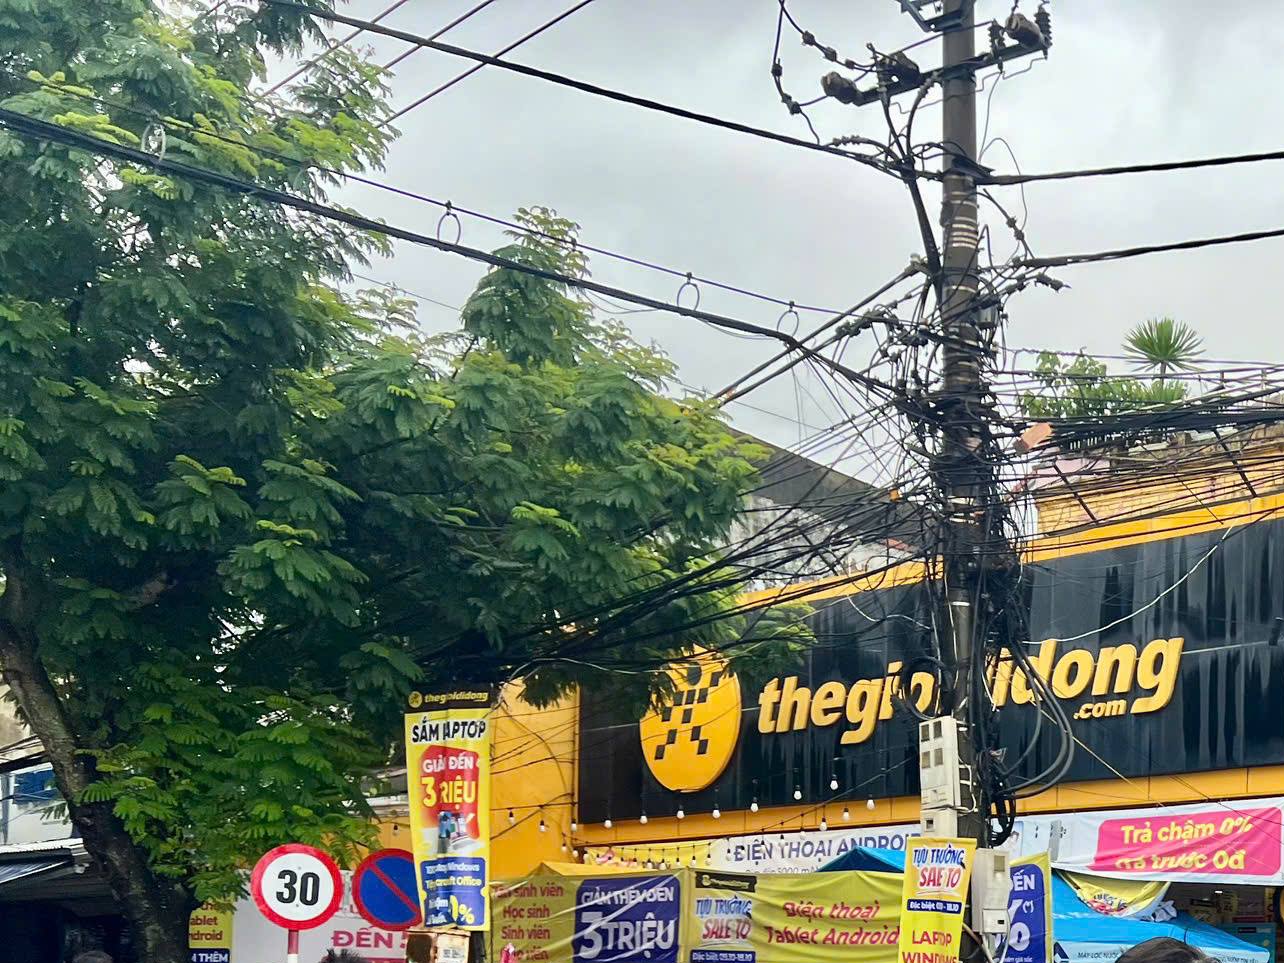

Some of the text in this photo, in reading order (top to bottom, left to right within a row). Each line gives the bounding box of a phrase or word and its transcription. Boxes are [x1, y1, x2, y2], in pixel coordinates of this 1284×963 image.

[1073, 699, 1127, 719] .com
[448, 752, 474, 770] ĐẾN
[421, 775, 476, 810] 3 RIỆU
[1120, 821, 1152, 844] Trả
[1157, 819, 1216, 845] chậm
[733, 840, 774, 866] ĐIỆN
[780, 837, 831, 863] THOẠI
[276, 869, 320, 906] 30
[541, 882, 564, 898] viên
[1010, 869, 1035, 892] ẾN
[190, 915, 218, 926] ablet
[503, 905, 550, 922] Học sinh
[783, 900, 880, 924] Điện thoại
[501, 925, 551, 940] Sinh viên
[579, 911, 676, 960] 3 TRIỆU
[702, 919, 731, 940] SALE
[765, 925, 900, 946] Tablet Android
